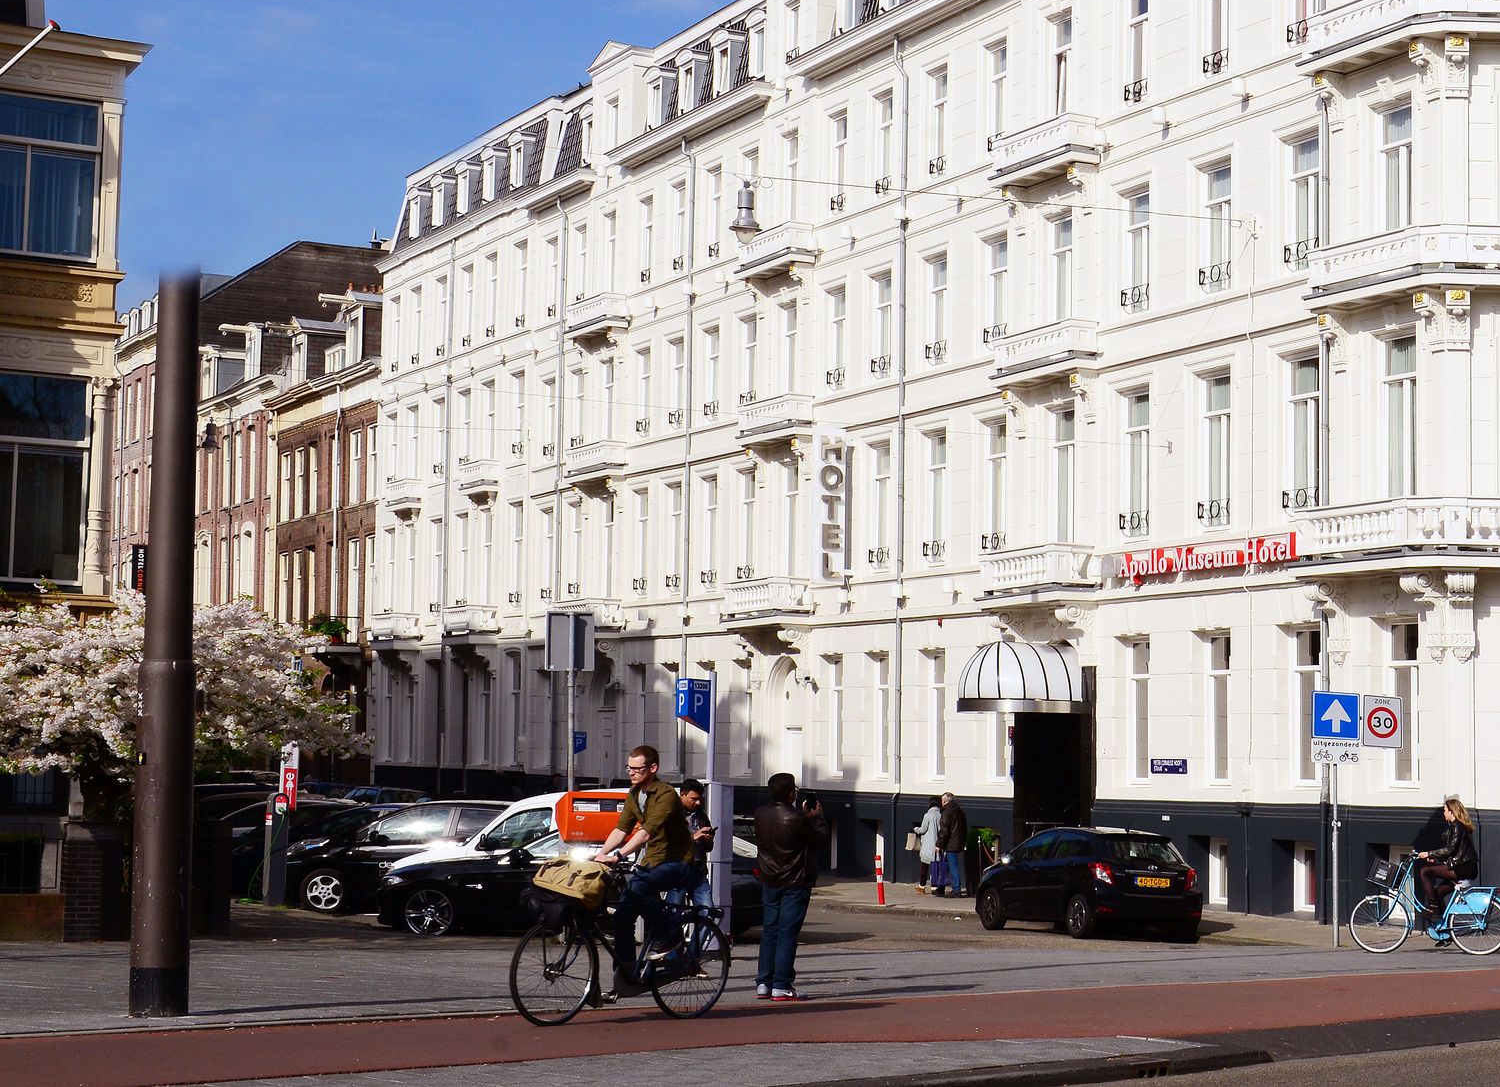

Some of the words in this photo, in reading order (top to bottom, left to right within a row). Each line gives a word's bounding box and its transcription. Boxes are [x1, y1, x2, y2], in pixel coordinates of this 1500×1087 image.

[820, 434, 844, 581] HOTEL
[1117, 548, 1168, 582] Apollo
[1171, 546, 1238, 573] Museum
[1243, 532, 1294, 564] Hotel
[678, 693, 685, 714] P
[694, 694, 704, 713] P
[1372, 716, 1393, 729] 30
[1313, 740, 1360, 748] uitgezonderd
